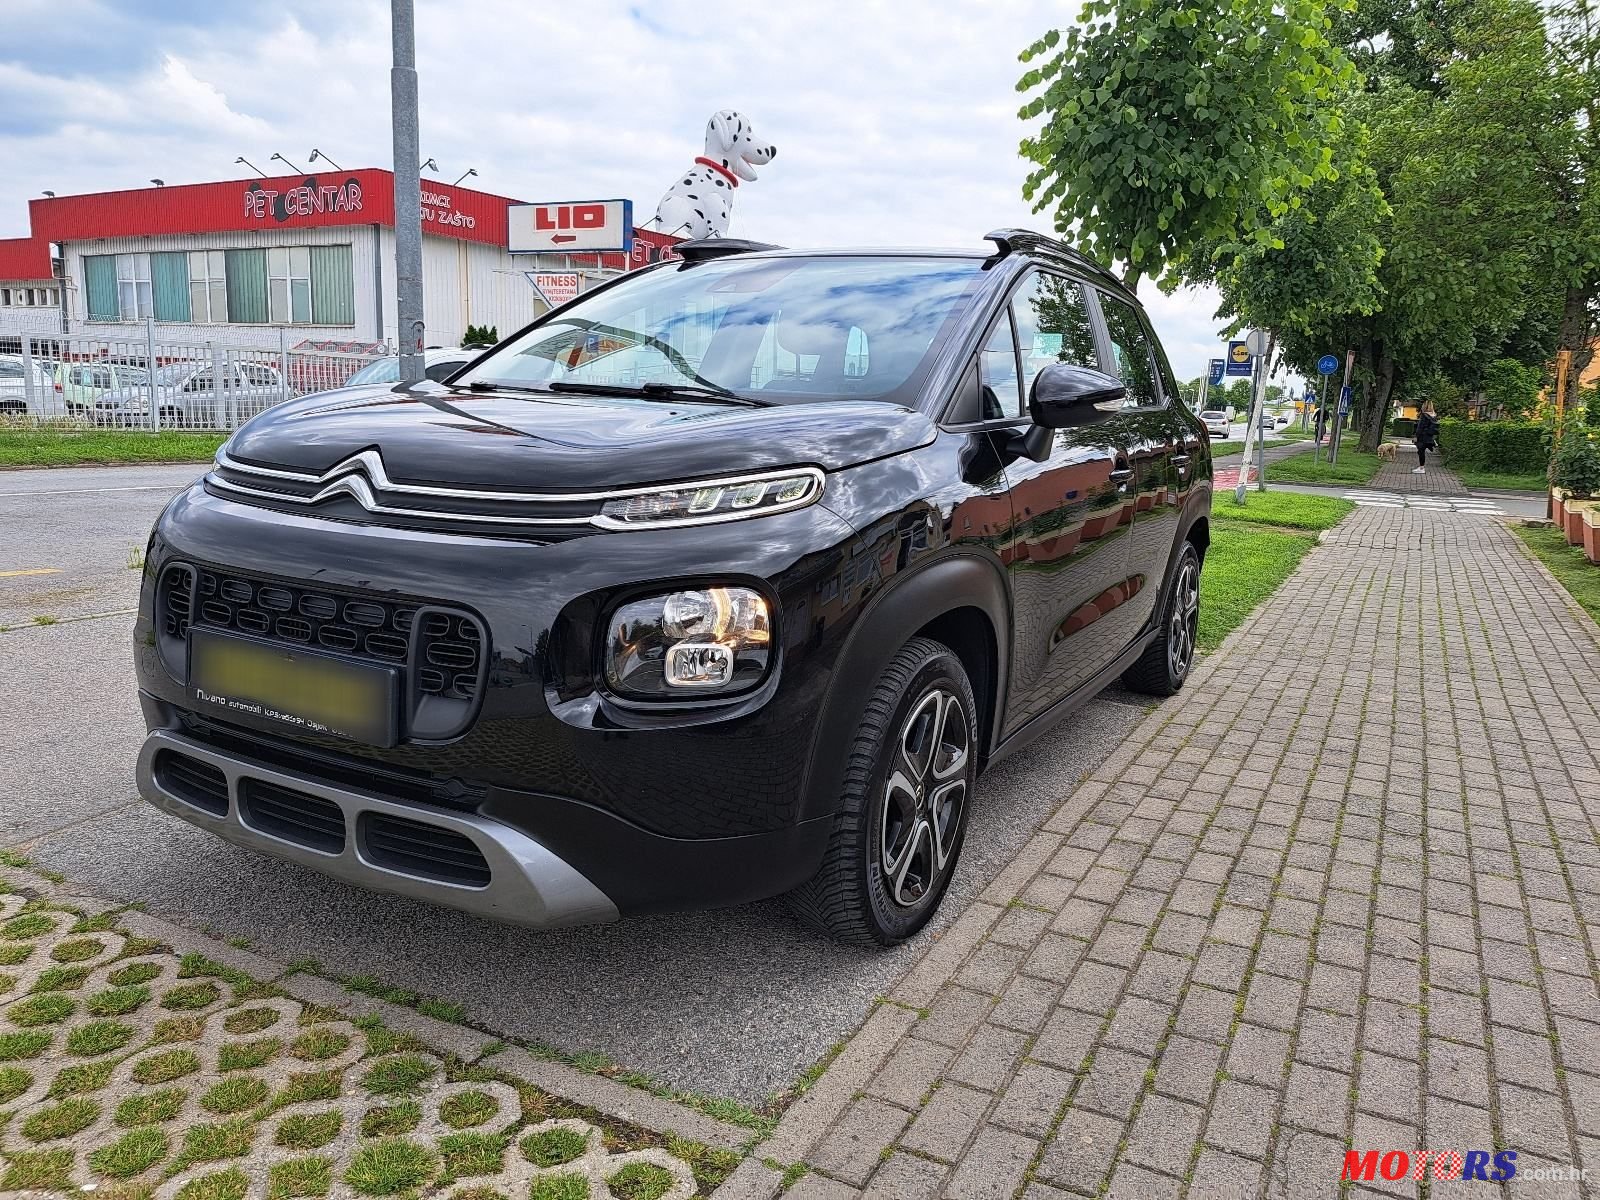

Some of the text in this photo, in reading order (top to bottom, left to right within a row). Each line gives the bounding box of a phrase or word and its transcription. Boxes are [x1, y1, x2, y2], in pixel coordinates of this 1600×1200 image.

[244, 183, 363, 218] PET CENTAR
[438, 210, 476, 229] ZAŠTO
[535, 204, 606, 231] LIO
[632, 237, 655, 263] ET
[536, 275, 577, 287] FITNESS
